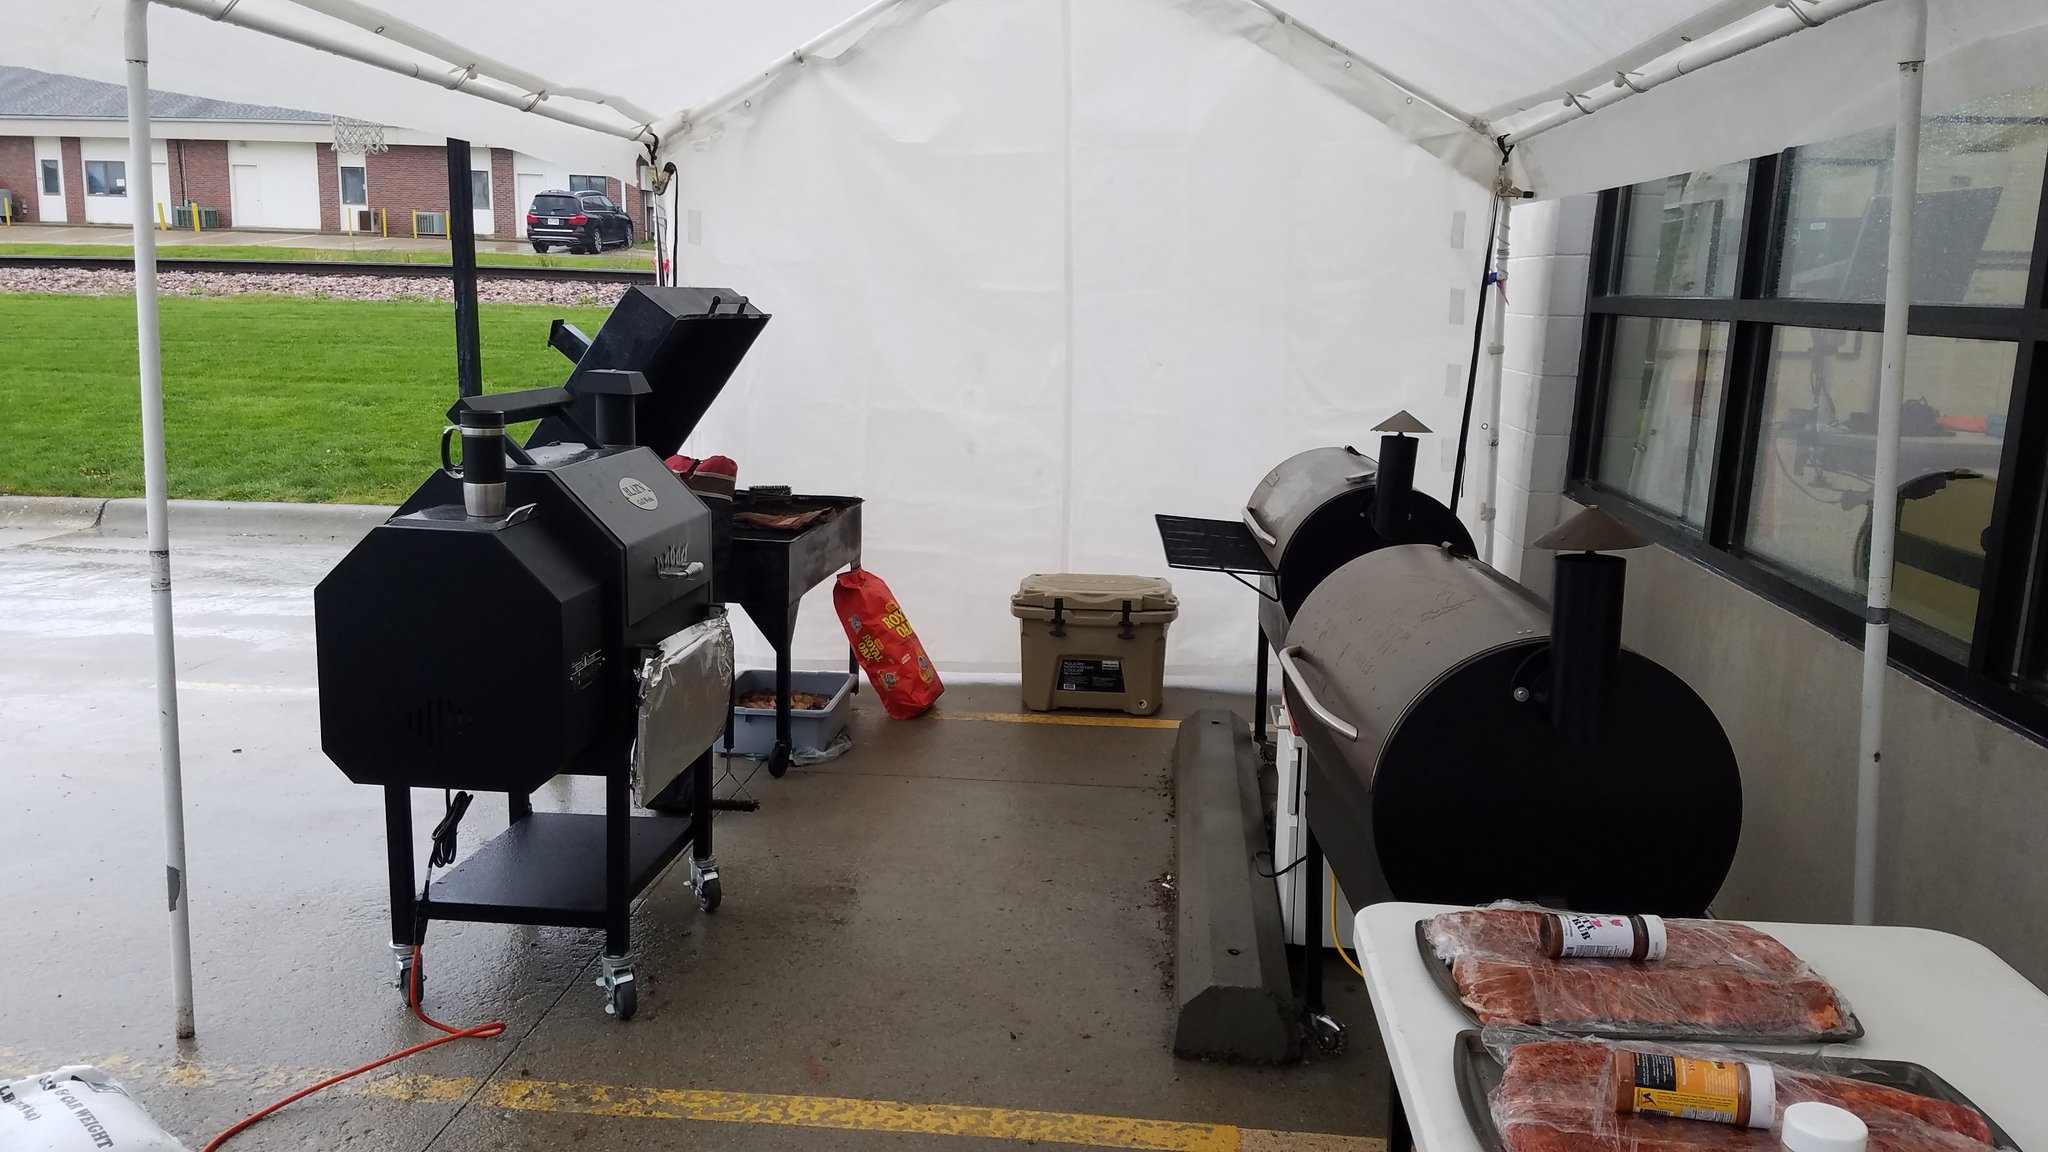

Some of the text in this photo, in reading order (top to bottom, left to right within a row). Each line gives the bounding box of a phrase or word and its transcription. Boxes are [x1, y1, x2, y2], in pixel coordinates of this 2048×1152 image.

[858, 642, 874, 661] OAK
[863, 634, 884, 663] ROYAL
[1572, 918, 1591, 940] RUB
[60, 1095, 84, 1111] CAR
[74, 1108, 114, 1149] WEIGHT
